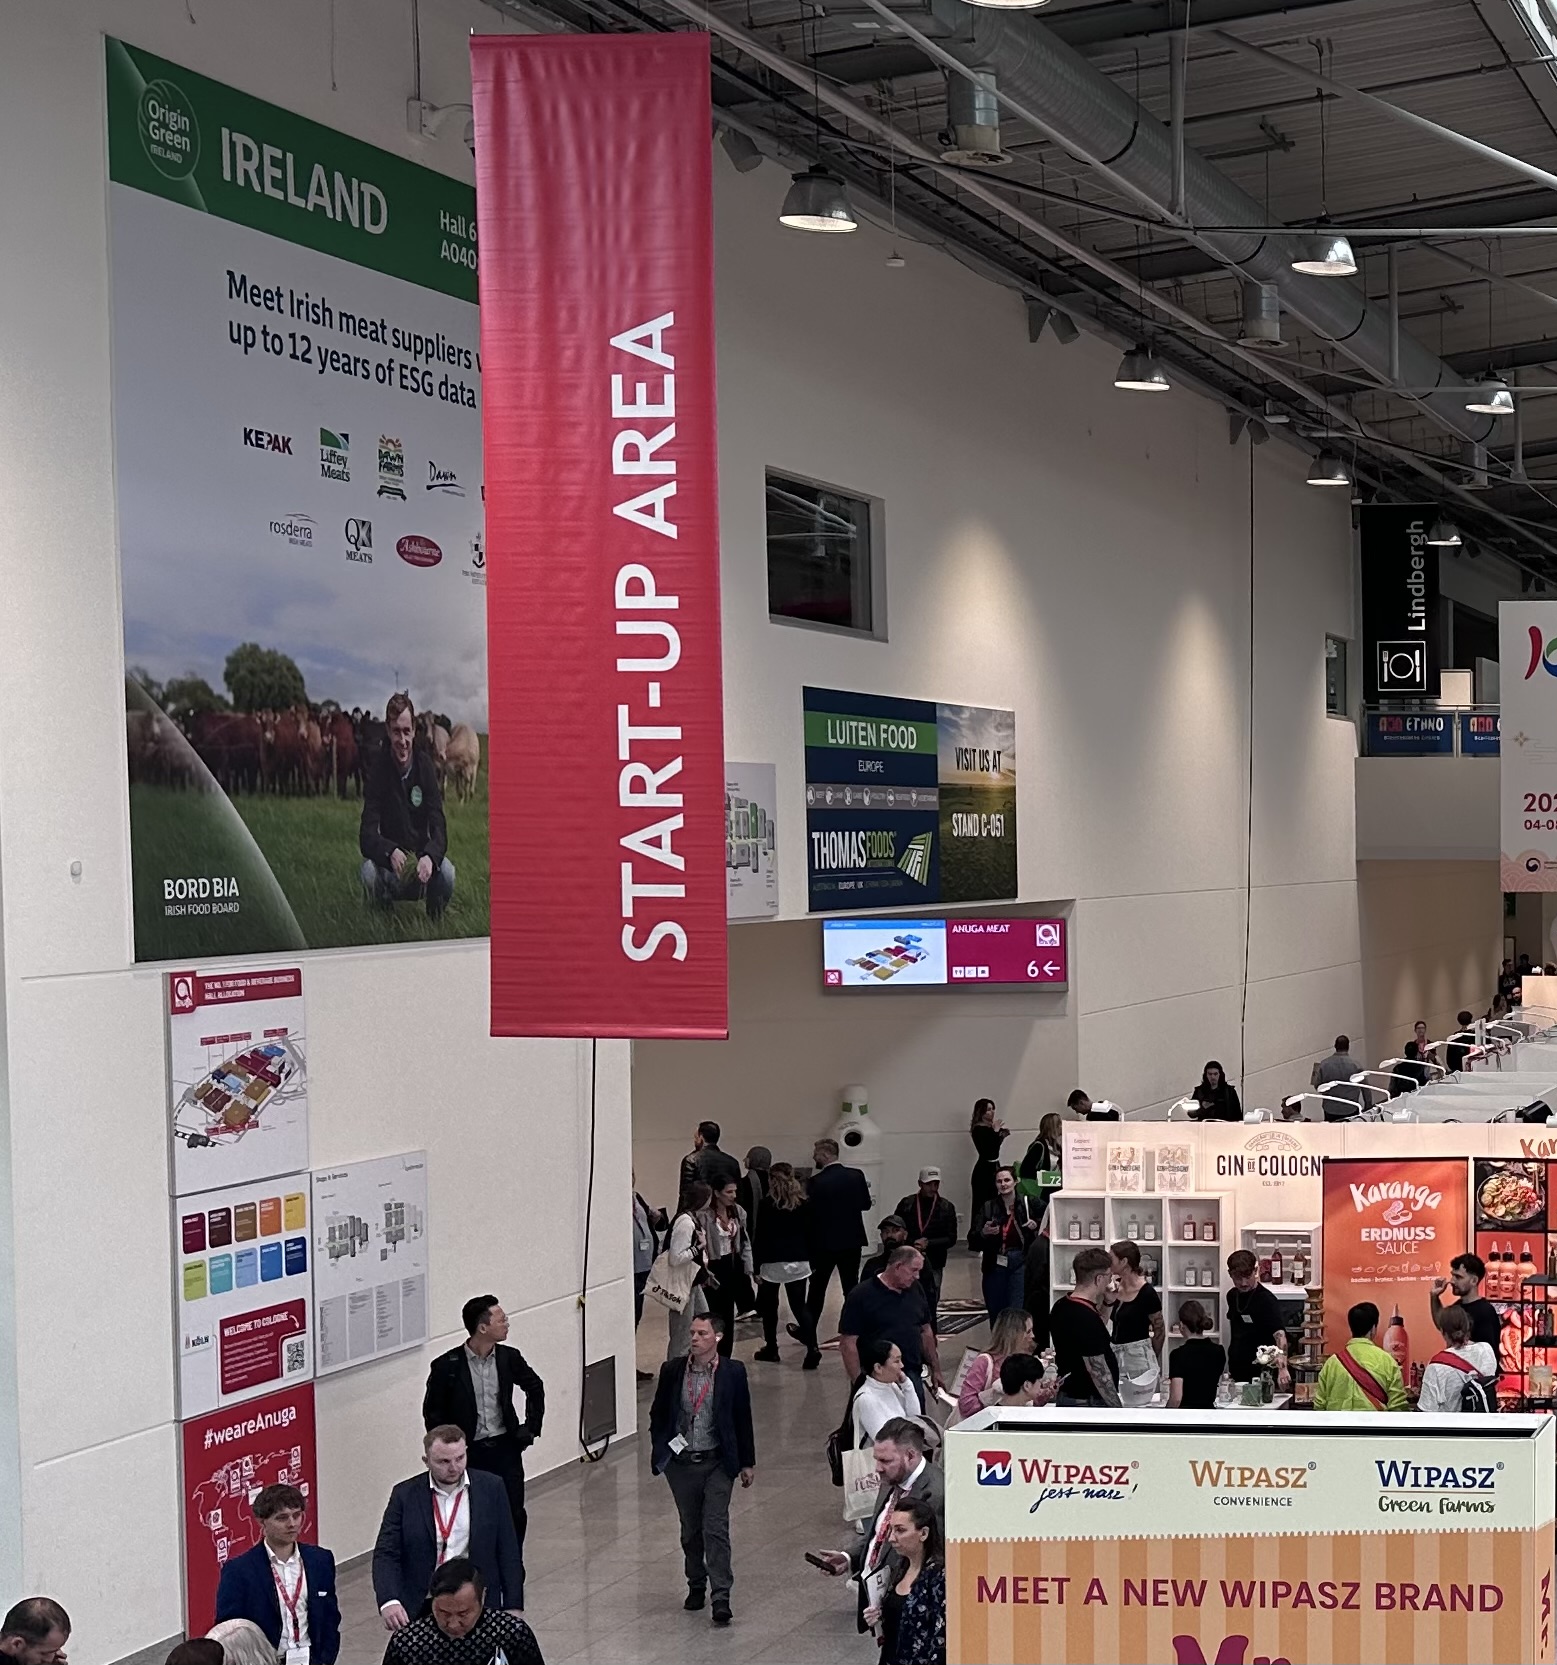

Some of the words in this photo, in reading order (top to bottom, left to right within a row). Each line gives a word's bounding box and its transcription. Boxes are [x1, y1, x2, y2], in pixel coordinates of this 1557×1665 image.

[147, 99, 190, 132] Origin
[148, 120, 191, 152] Green
[220, 126, 389, 235] IRELAND
[439, 209, 466, 239] Hall
[468, 223, 477, 243] 6
[226, 270, 284, 316] Meet
[289, 288, 333, 329] Irish
[339, 308, 387, 346] meat
[392, 328, 472, 371] suppliers
[228, 320, 255, 355] up
[262, 326, 283, 357] to
[288, 331, 312, 365] 12
[318, 345, 370, 380] years
[375, 360, 394, 387] of
[399, 364, 434, 398] ESG
[438, 376, 476, 409] data
[609, 311, 679, 540] AREA
[243, 427, 293, 455] KEPAK
[320, 448, 349, 469] Liffey
[320, 464, 350, 483] Meats
[269, 519, 312, 540] rosderra
[346, 550, 373, 564] MEATS
[1406, 520, 1429, 631] Lindbergh
[828, 719, 876, 747] LUITEN
[880, 725, 917, 749] FOOD
[1406, 717, 1444, 732] ETHNO
[615, 562, 689, 962] START-UP
[858, 759, 884, 773] EUROPE
[955, 747, 976, 772] VISIT
[978, 750, 990, 773] US
[992, 750, 1002, 773] AT
[952, 813, 978, 837] STAND
[981, 813, 1005, 837] C-051
[164, 879, 210, 900] BORD
[213, 877, 239, 897] BIA
[165, 904, 186, 916] IRISH
[188, 903, 211, 915] FOOD
[212, 902, 239, 914] BOARD
[952, 924, 985, 934] ANUGA
[985, 924, 1010, 934] MEAT
[1026, 961, 1039, 977] 6
[1216, 1155, 1244, 1176] GIN
[1258, 1154, 1329, 1176] COLOGN
[1049, 1175, 1062, 1186] 72
[1349, 1180, 1443, 1213] Karanga
[1361, 1227, 1436, 1241] ERDNUSS
[1376, 1242, 1419, 1254] SAUCE
[204, 1406, 297, 1449] #weareAnuga
[1031, 1486, 1074, 1514] jest
[1213, 1496, 1293, 1507] CONVENIENCE
[1378, 1496, 1433, 1514] Green
[1438, 1495, 1496, 1514] Farms
[977, 1576, 1071, 1604] MEET
[1083, 1577, 1109, 1606] A
[1123, 1578, 1208, 1607] NEW
[1219, 1580, 1362, 1610] WIPASZ
[1375, 1582, 1504, 1612] BRAND
